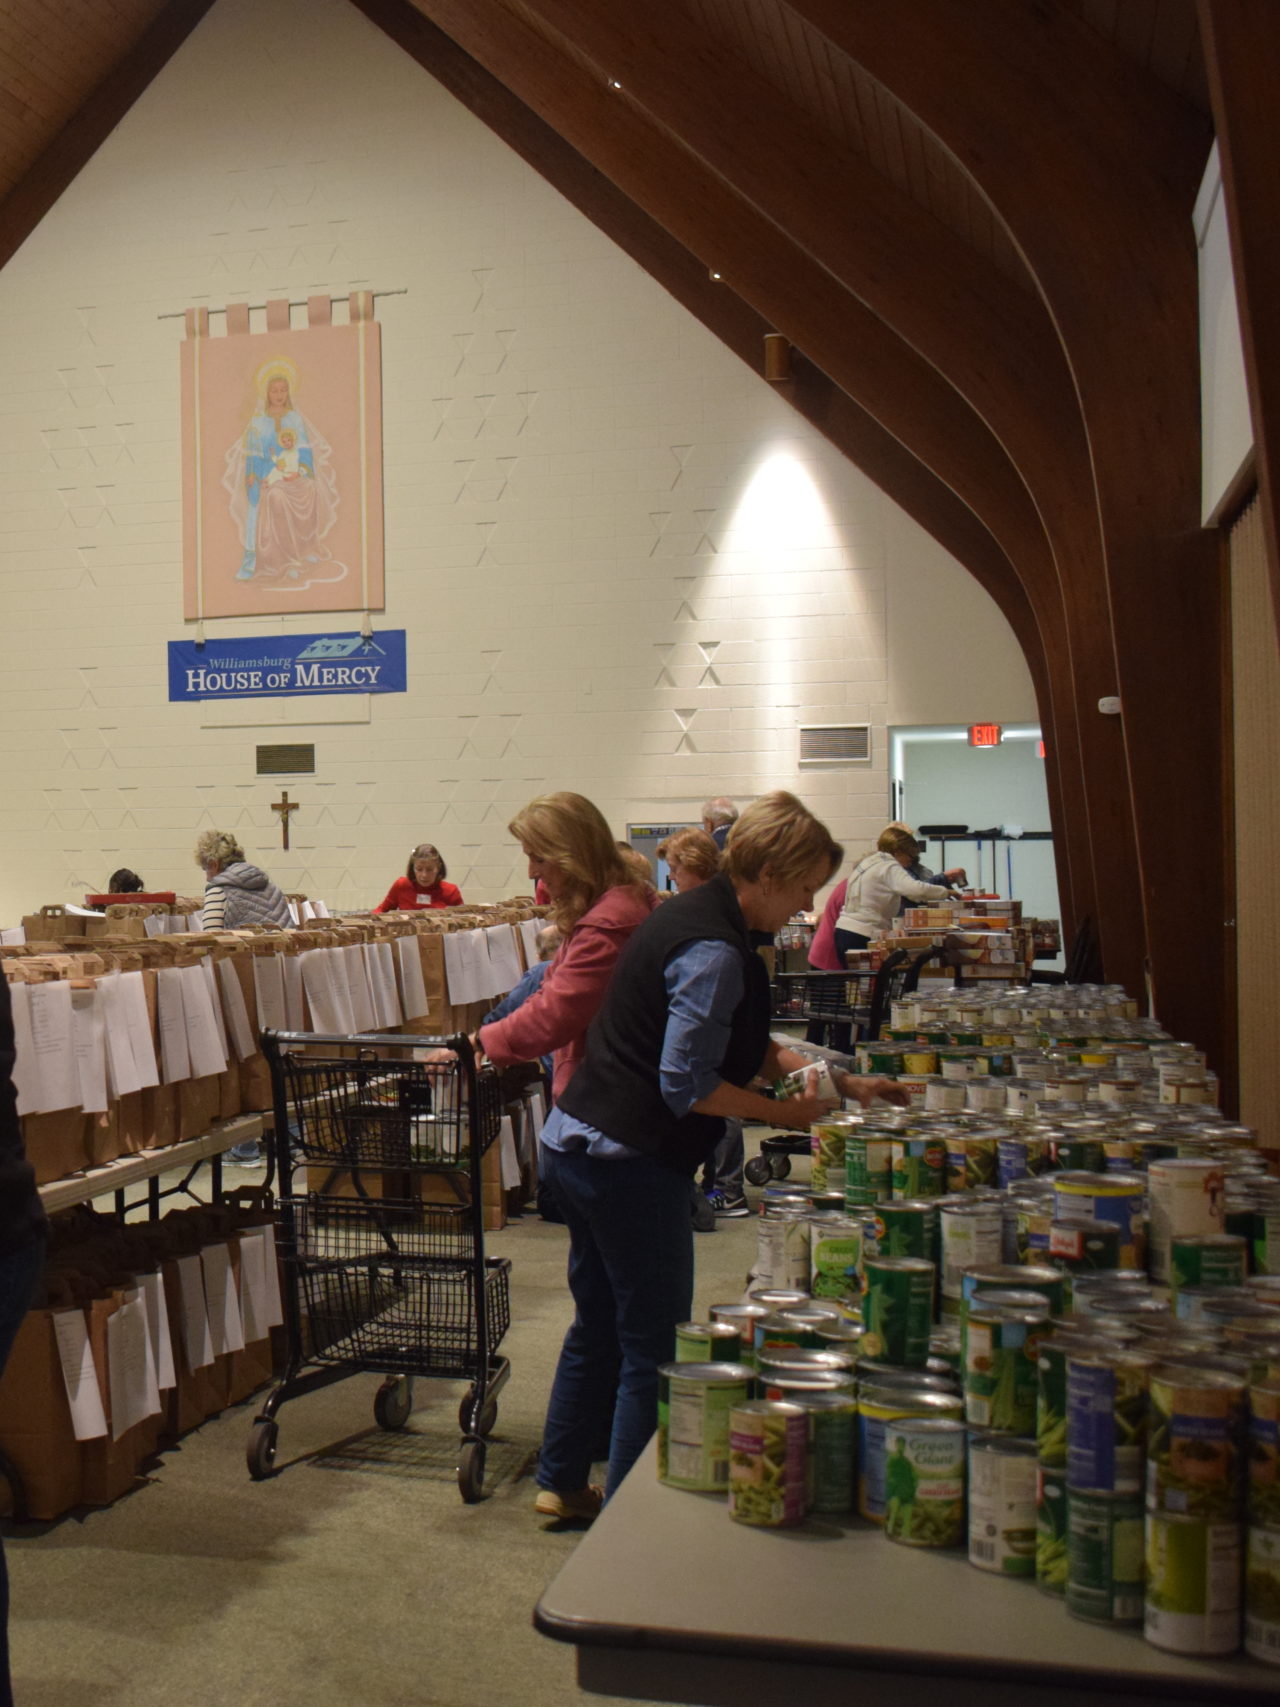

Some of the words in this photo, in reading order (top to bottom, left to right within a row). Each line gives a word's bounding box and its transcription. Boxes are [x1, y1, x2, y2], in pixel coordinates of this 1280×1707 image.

[209, 656, 292, 671] Williamsburg
[186, 669, 263, 691] HOUSE
[266, 673, 290, 688] OF
[295, 664, 381, 686] MERCY
[973, 726, 998, 745] EXIT
